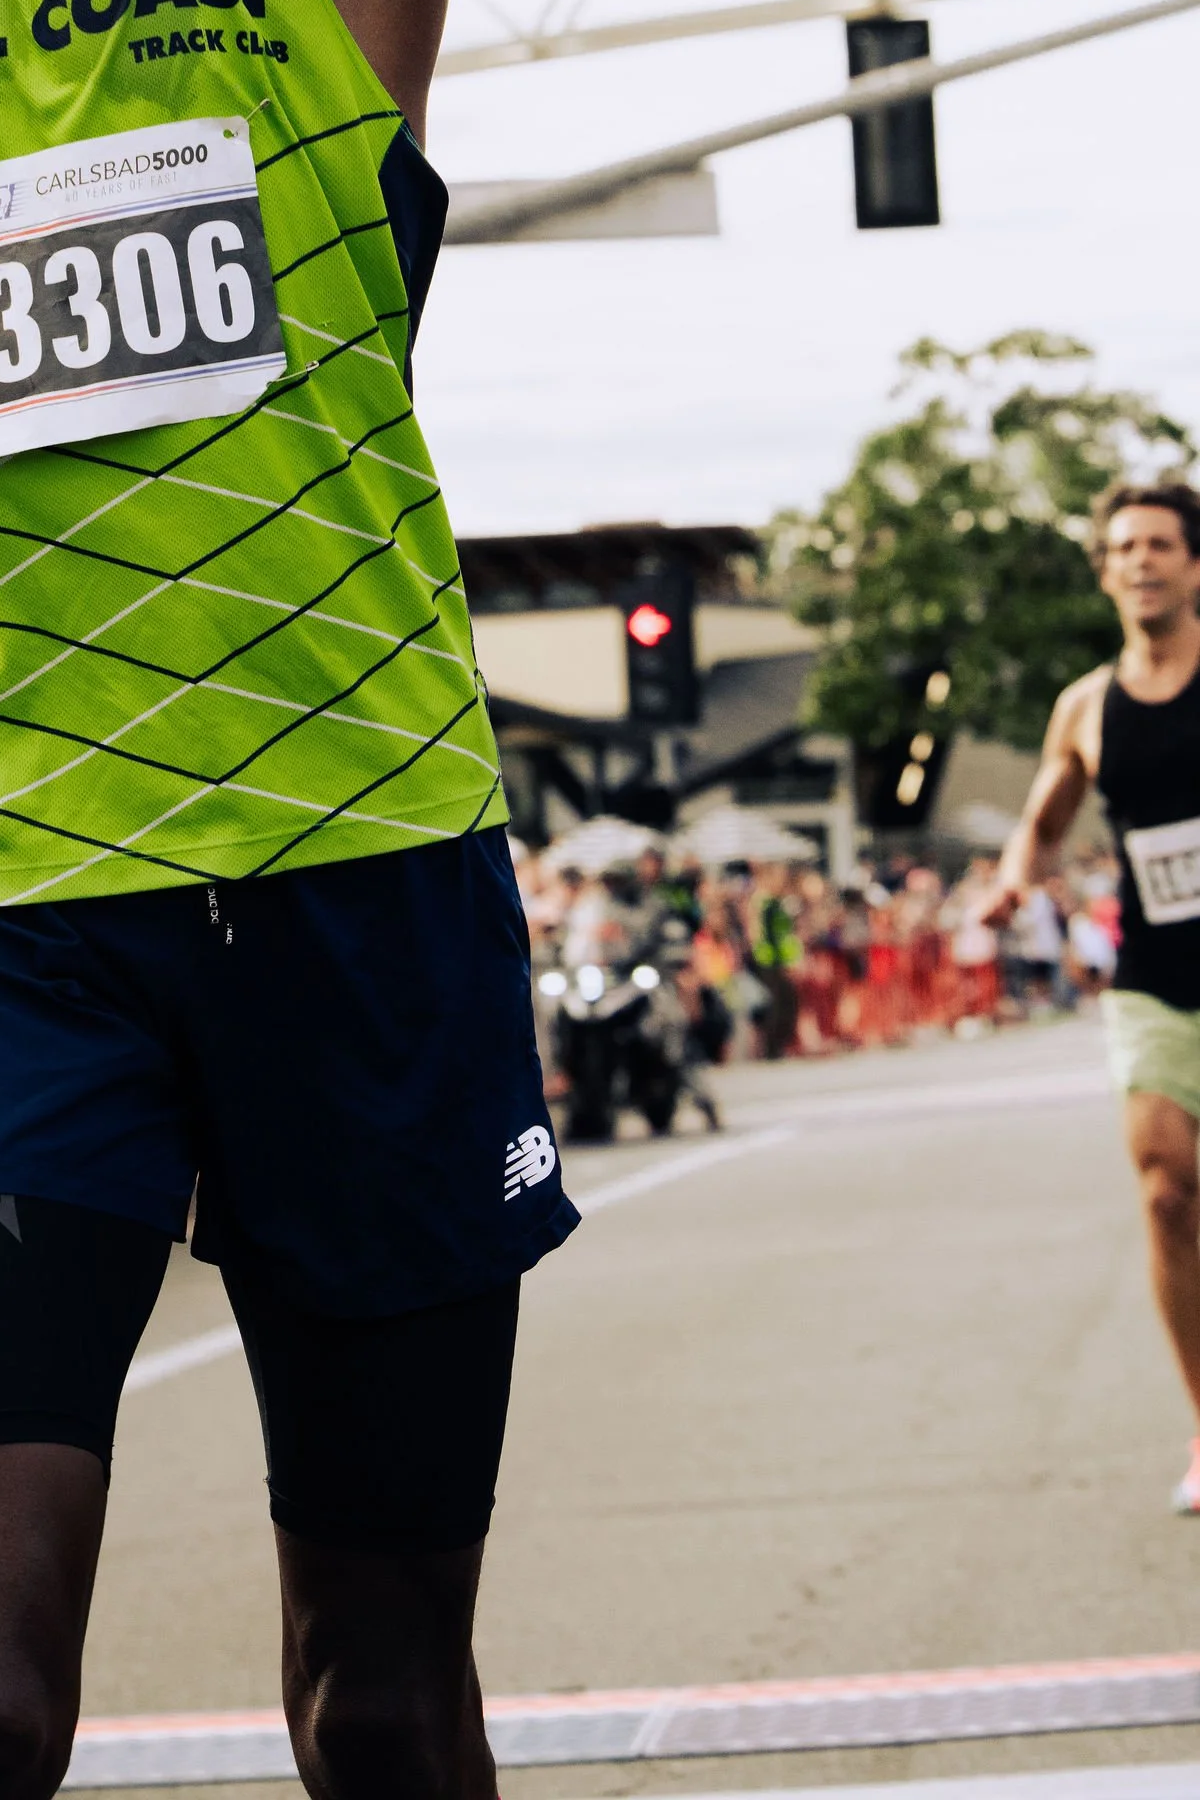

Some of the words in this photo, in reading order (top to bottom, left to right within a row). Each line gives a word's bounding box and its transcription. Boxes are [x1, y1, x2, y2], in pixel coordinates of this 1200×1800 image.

[128, 28, 227, 64] TRACK
[236, 30, 289, 64] CLUB
[35, 143, 208, 196] CARLSBAD5000
[85, 183, 122, 199] YEARS
[129, 178, 143, 191] OF
[150, 171, 177, 186] FAST
